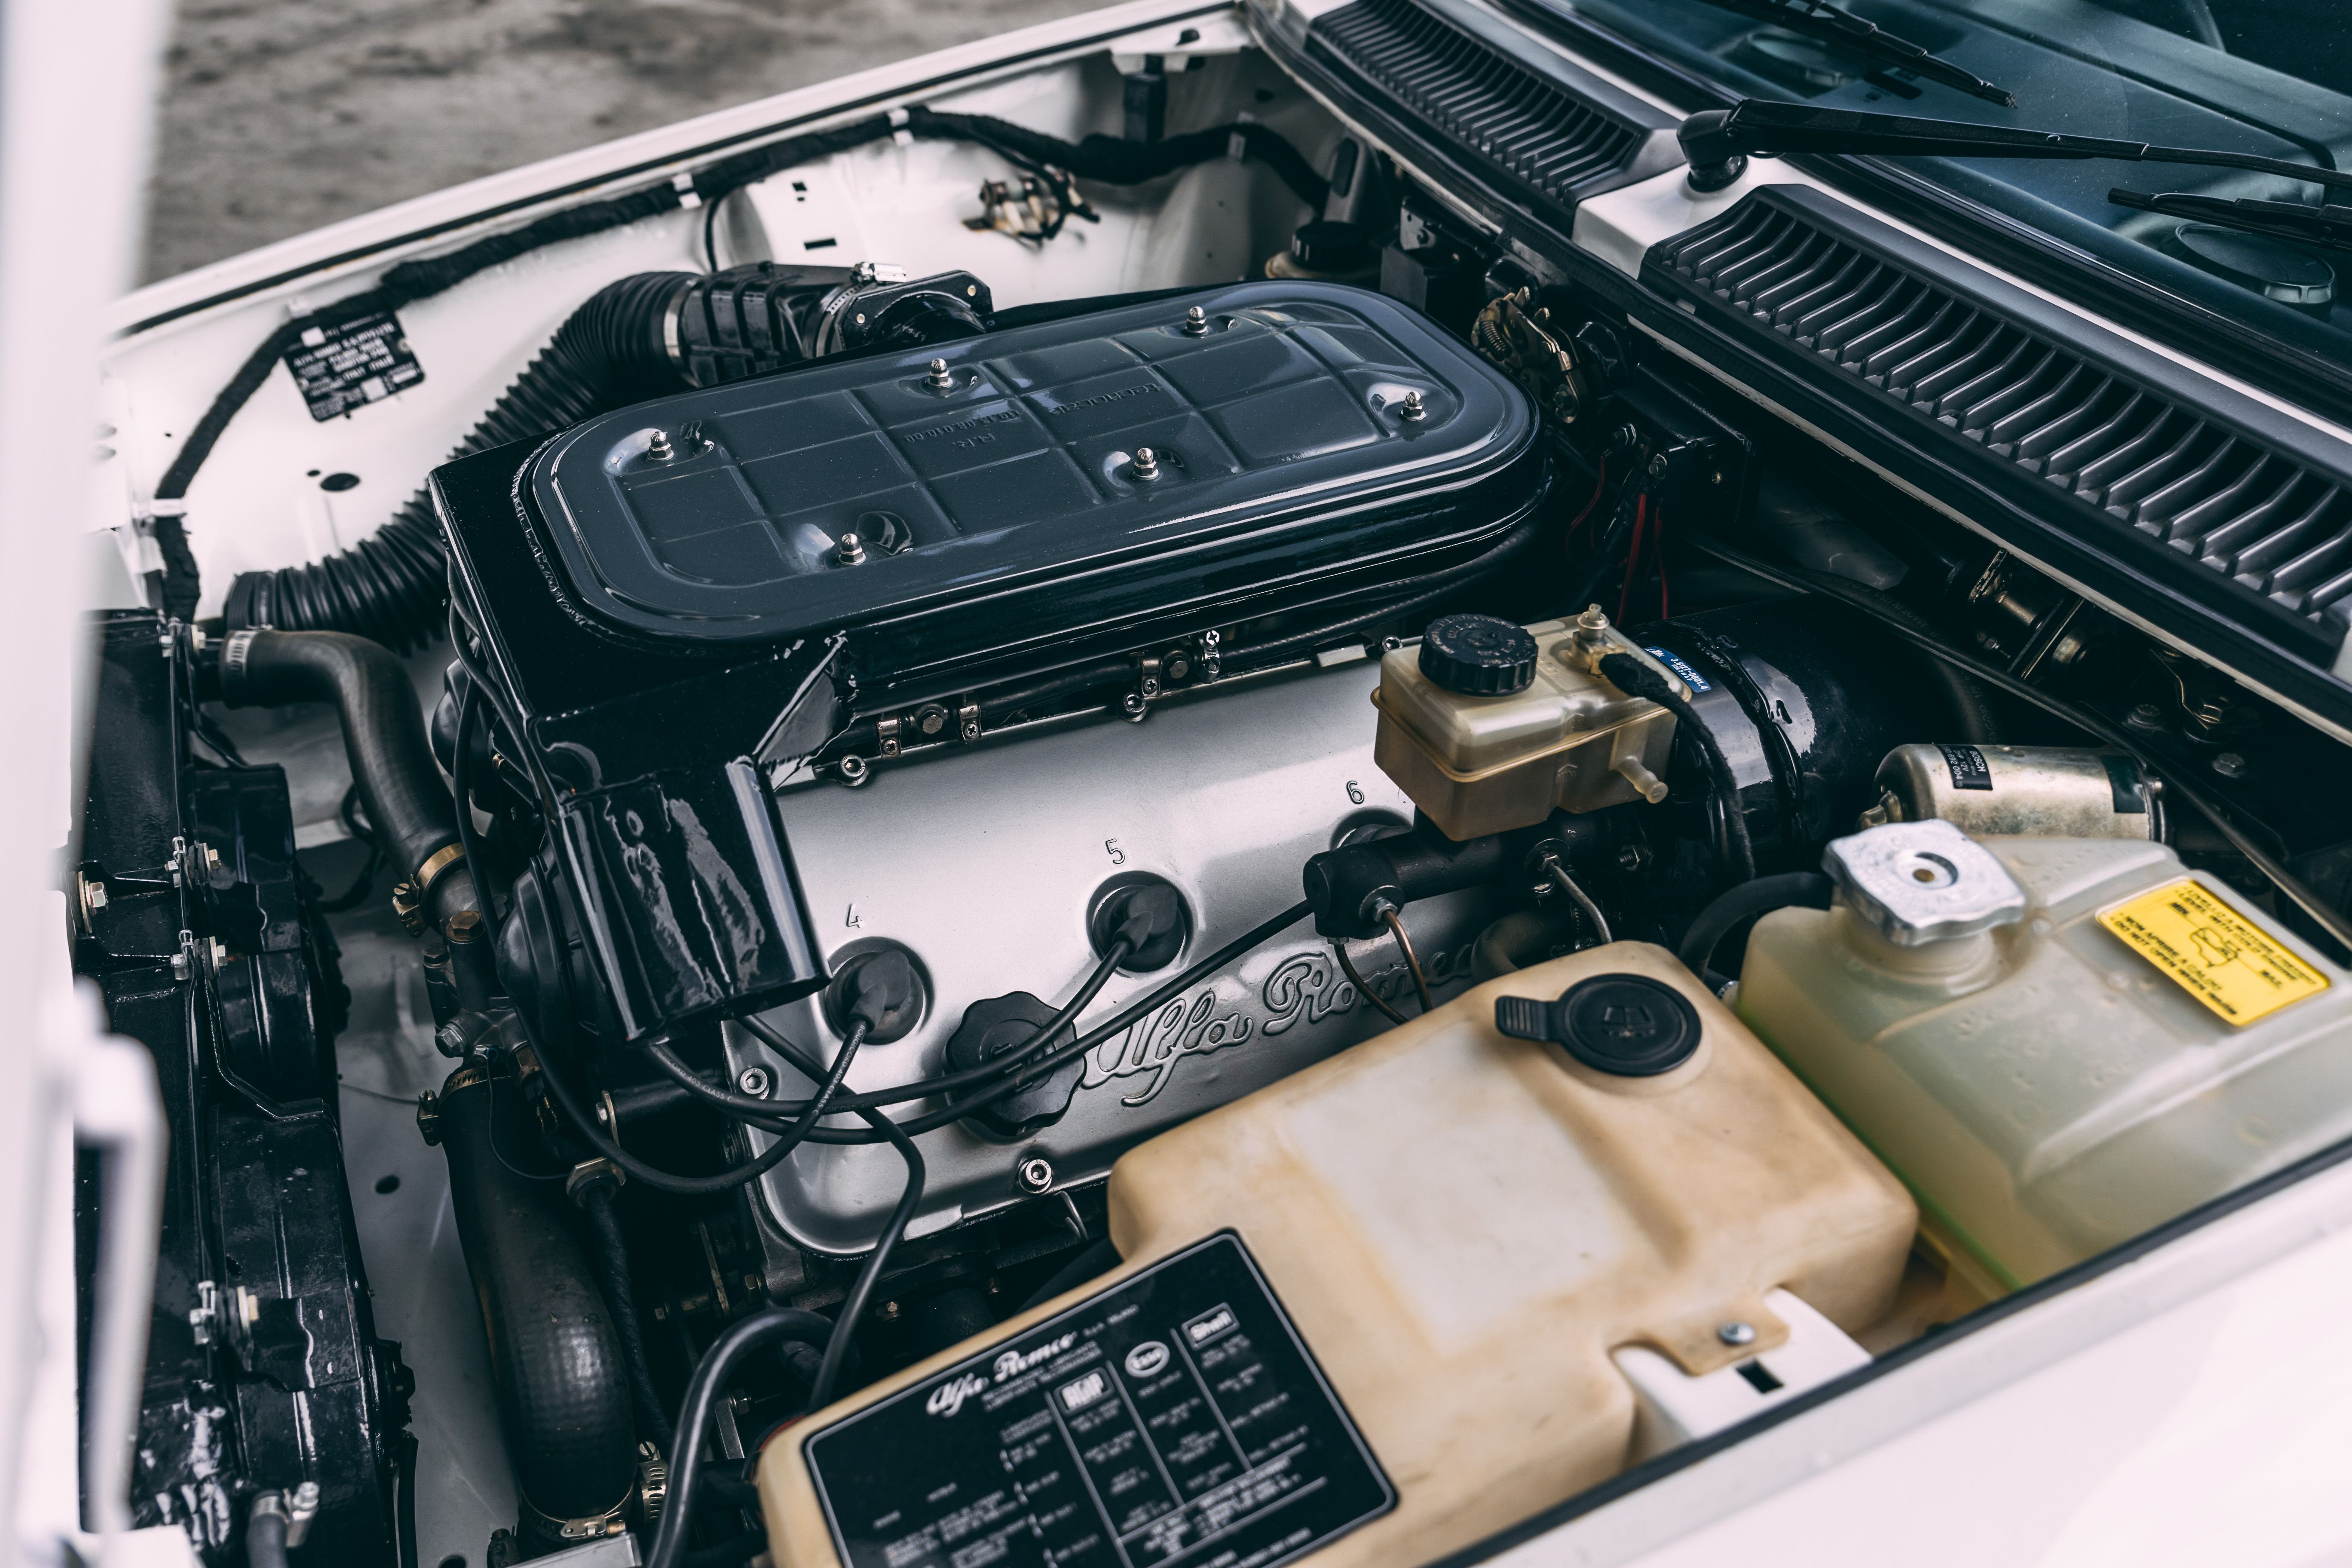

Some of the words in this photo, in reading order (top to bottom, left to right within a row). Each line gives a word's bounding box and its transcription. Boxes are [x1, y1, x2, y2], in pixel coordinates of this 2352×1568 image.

[1670, 658, 1709, 690] 3.6127-0801.4
[1948, 754, 1958, 765] 692
[1960, 761, 1969, 772] 12V
[1970, 750, 1986, 772] BOSCH
[1952, 766, 1963, 780] 004
[1345, 780, 1364, 804] 6
[1104, 838, 1127, 865] 5
[845, 903, 864, 928] 4
[2125, 916, 2145, 931] NON
[2115, 921, 2130, 931] DO
[2131, 932, 2149, 945] NOT
[842, 1024, 866, 1067] BOUGICORD
[1081, 988, 1254, 1107] Alfa
[687, 1076, 701, 1087] 403
[702, 1085, 725, 1099] CLASS
[833, 1069, 843, 1084] 403
[818, 1085, 835, 1108] CLASS
[824, 1104, 858, 1113] GICORD
[1191, 1311, 1231, 1341] Shell
[927, 1373, 993, 1416] Alfa
[995, 1333, 1075, 1381] Romeo
